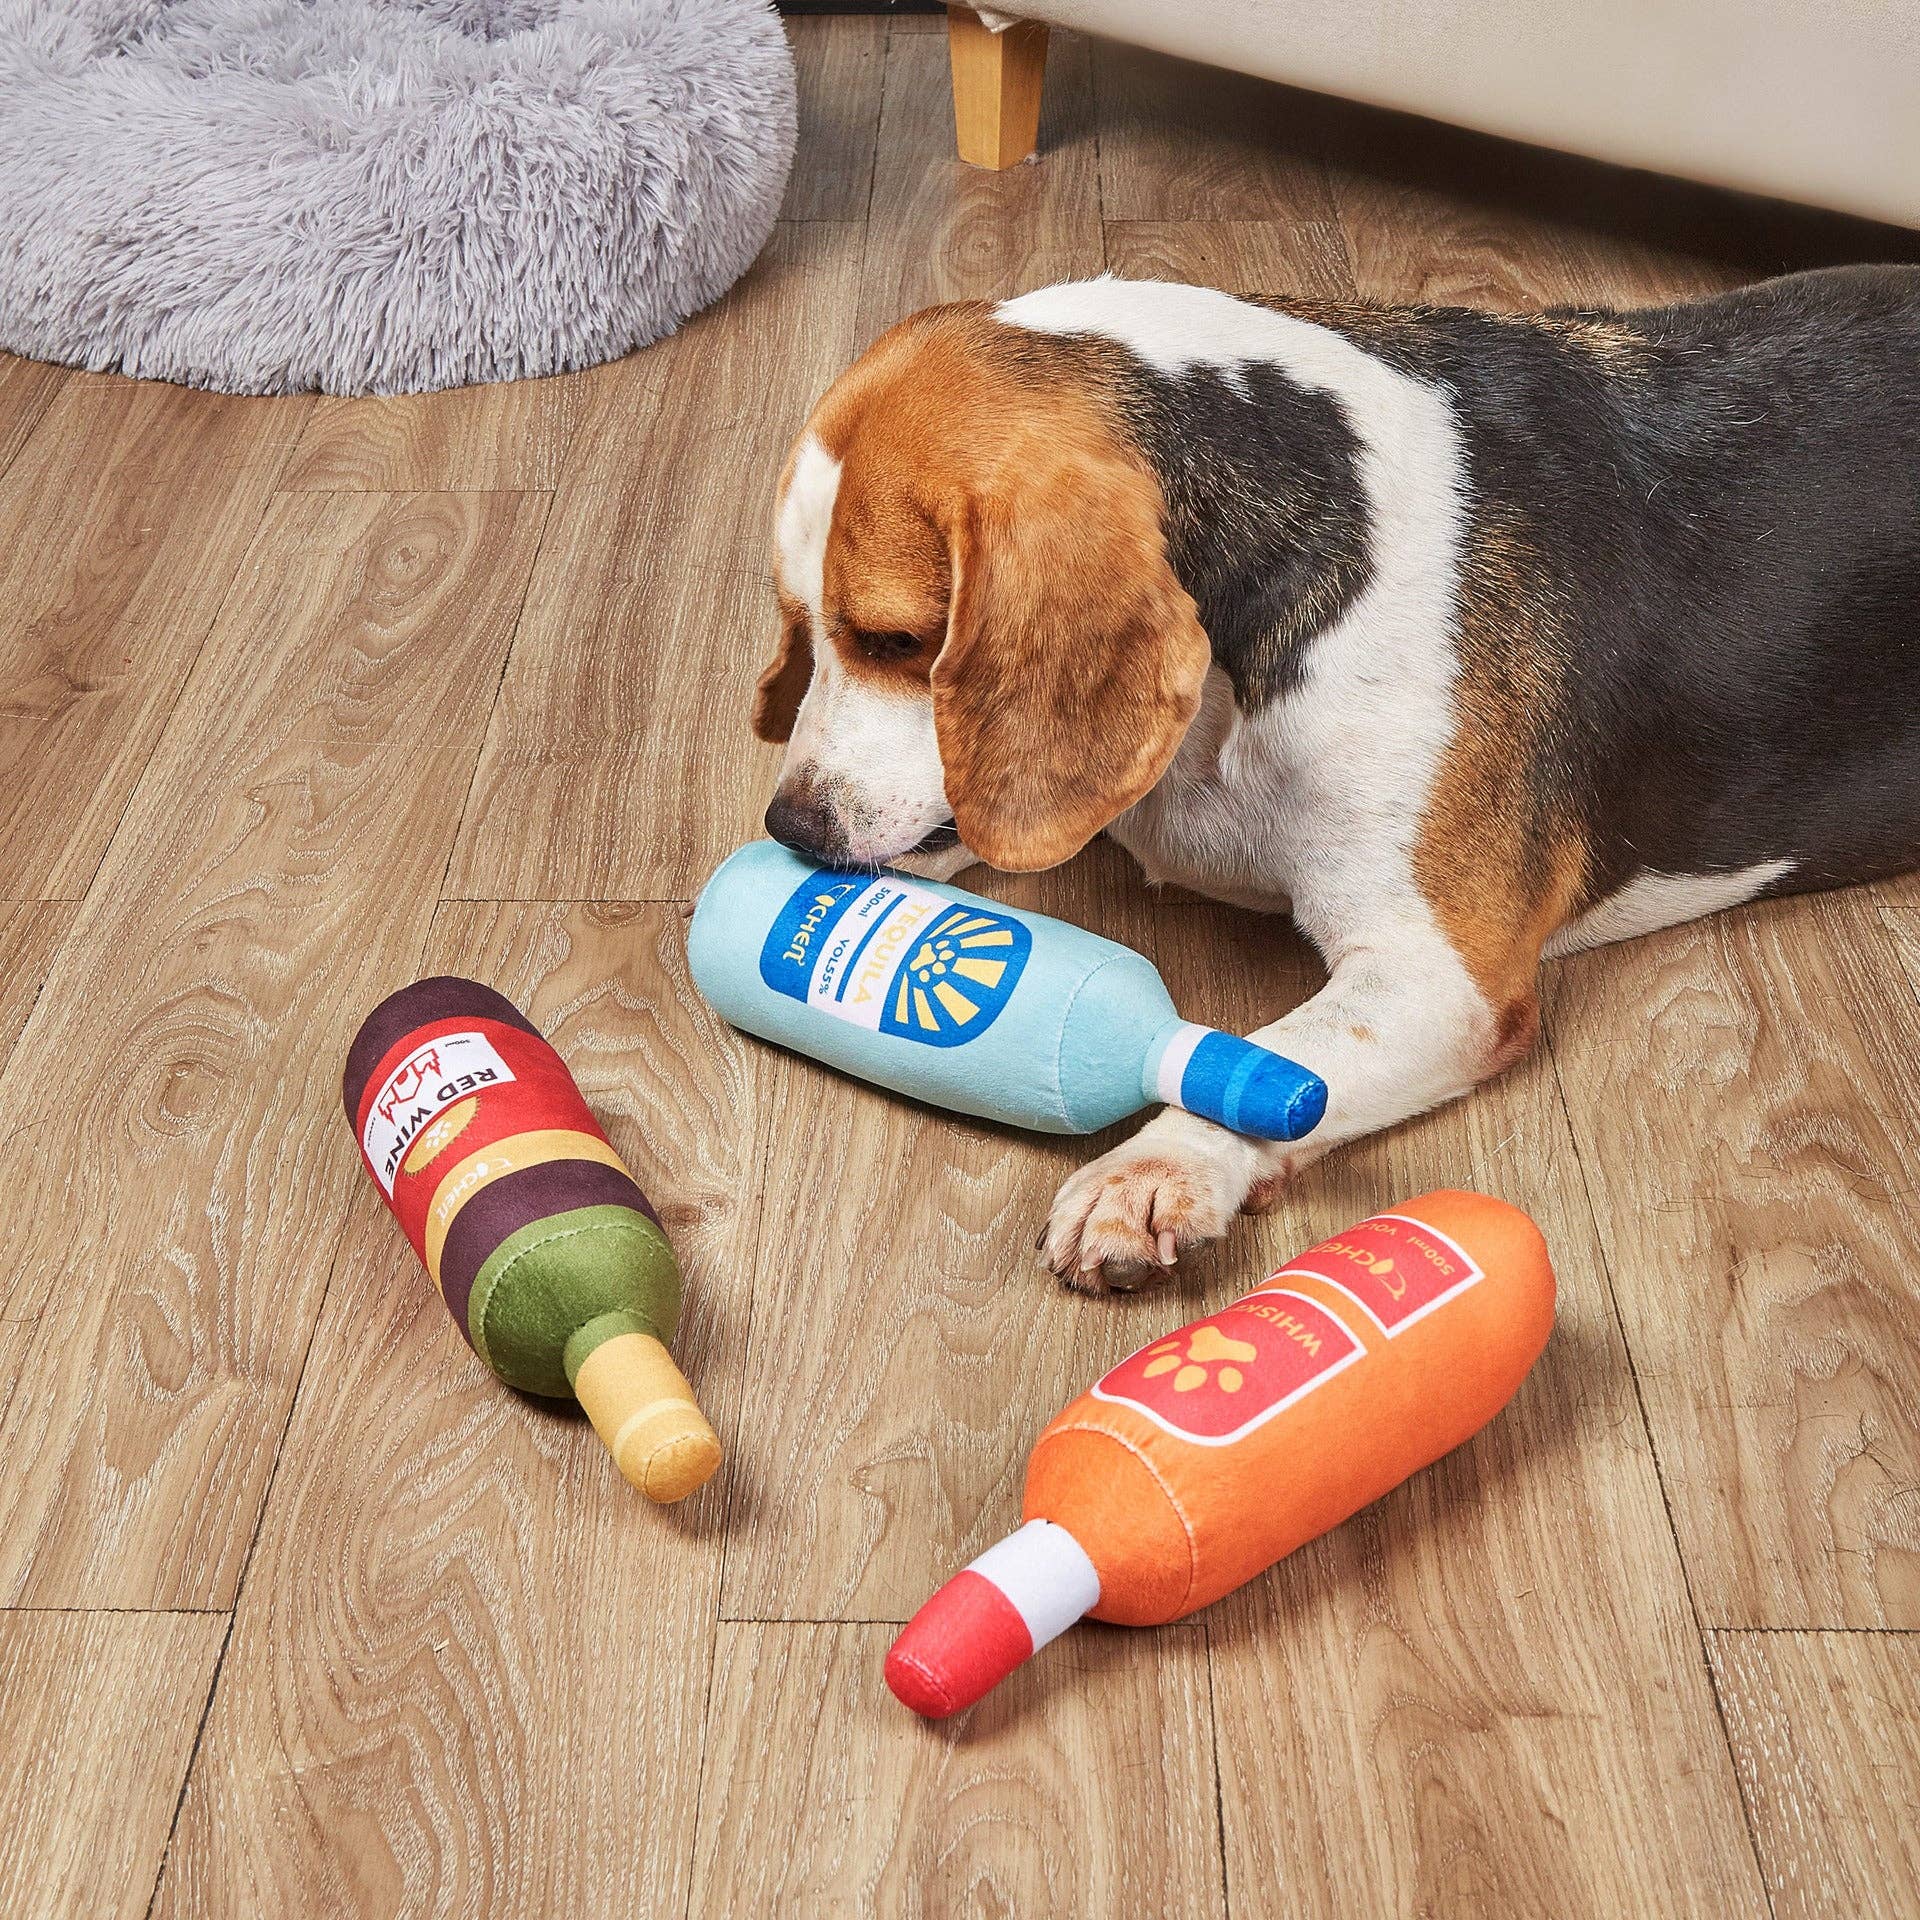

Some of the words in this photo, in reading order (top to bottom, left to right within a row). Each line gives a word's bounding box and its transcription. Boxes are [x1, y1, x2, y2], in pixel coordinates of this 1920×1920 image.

[857, 886, 891, 919] 500ml
[818, 938, 850, 996] VOL55%
[853, 900, 932, 1005] TEQUILA
[436, 1067, 498, 1102] RED
[385, 1107, 432, 1181] WINE
[1406, 1236, 1456, 1276] 500ml
